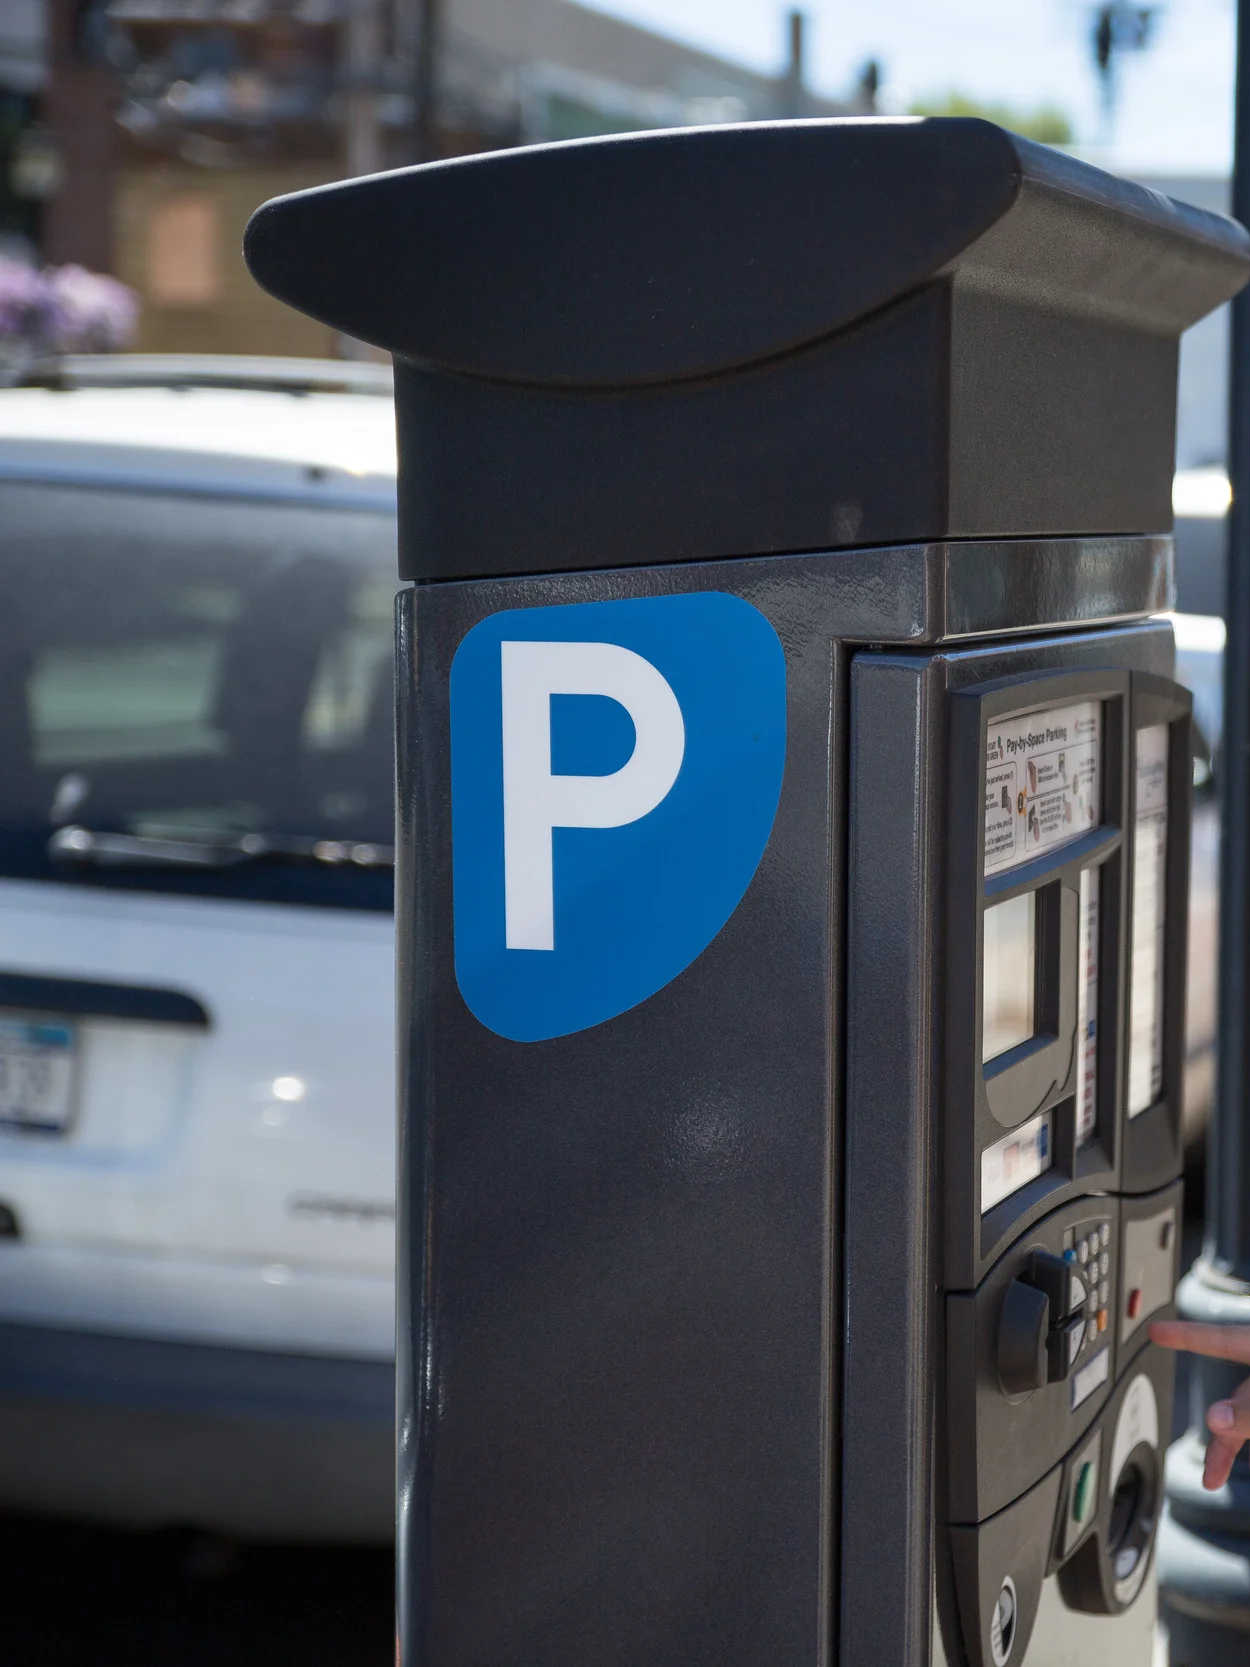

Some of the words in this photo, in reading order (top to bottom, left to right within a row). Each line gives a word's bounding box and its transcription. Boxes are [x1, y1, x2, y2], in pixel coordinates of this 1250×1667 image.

[501, 640, 685, 951] P
[1006, 732, 1045, 755] Pay-by-Space
[1046, 726, 1067, 742] Parking
